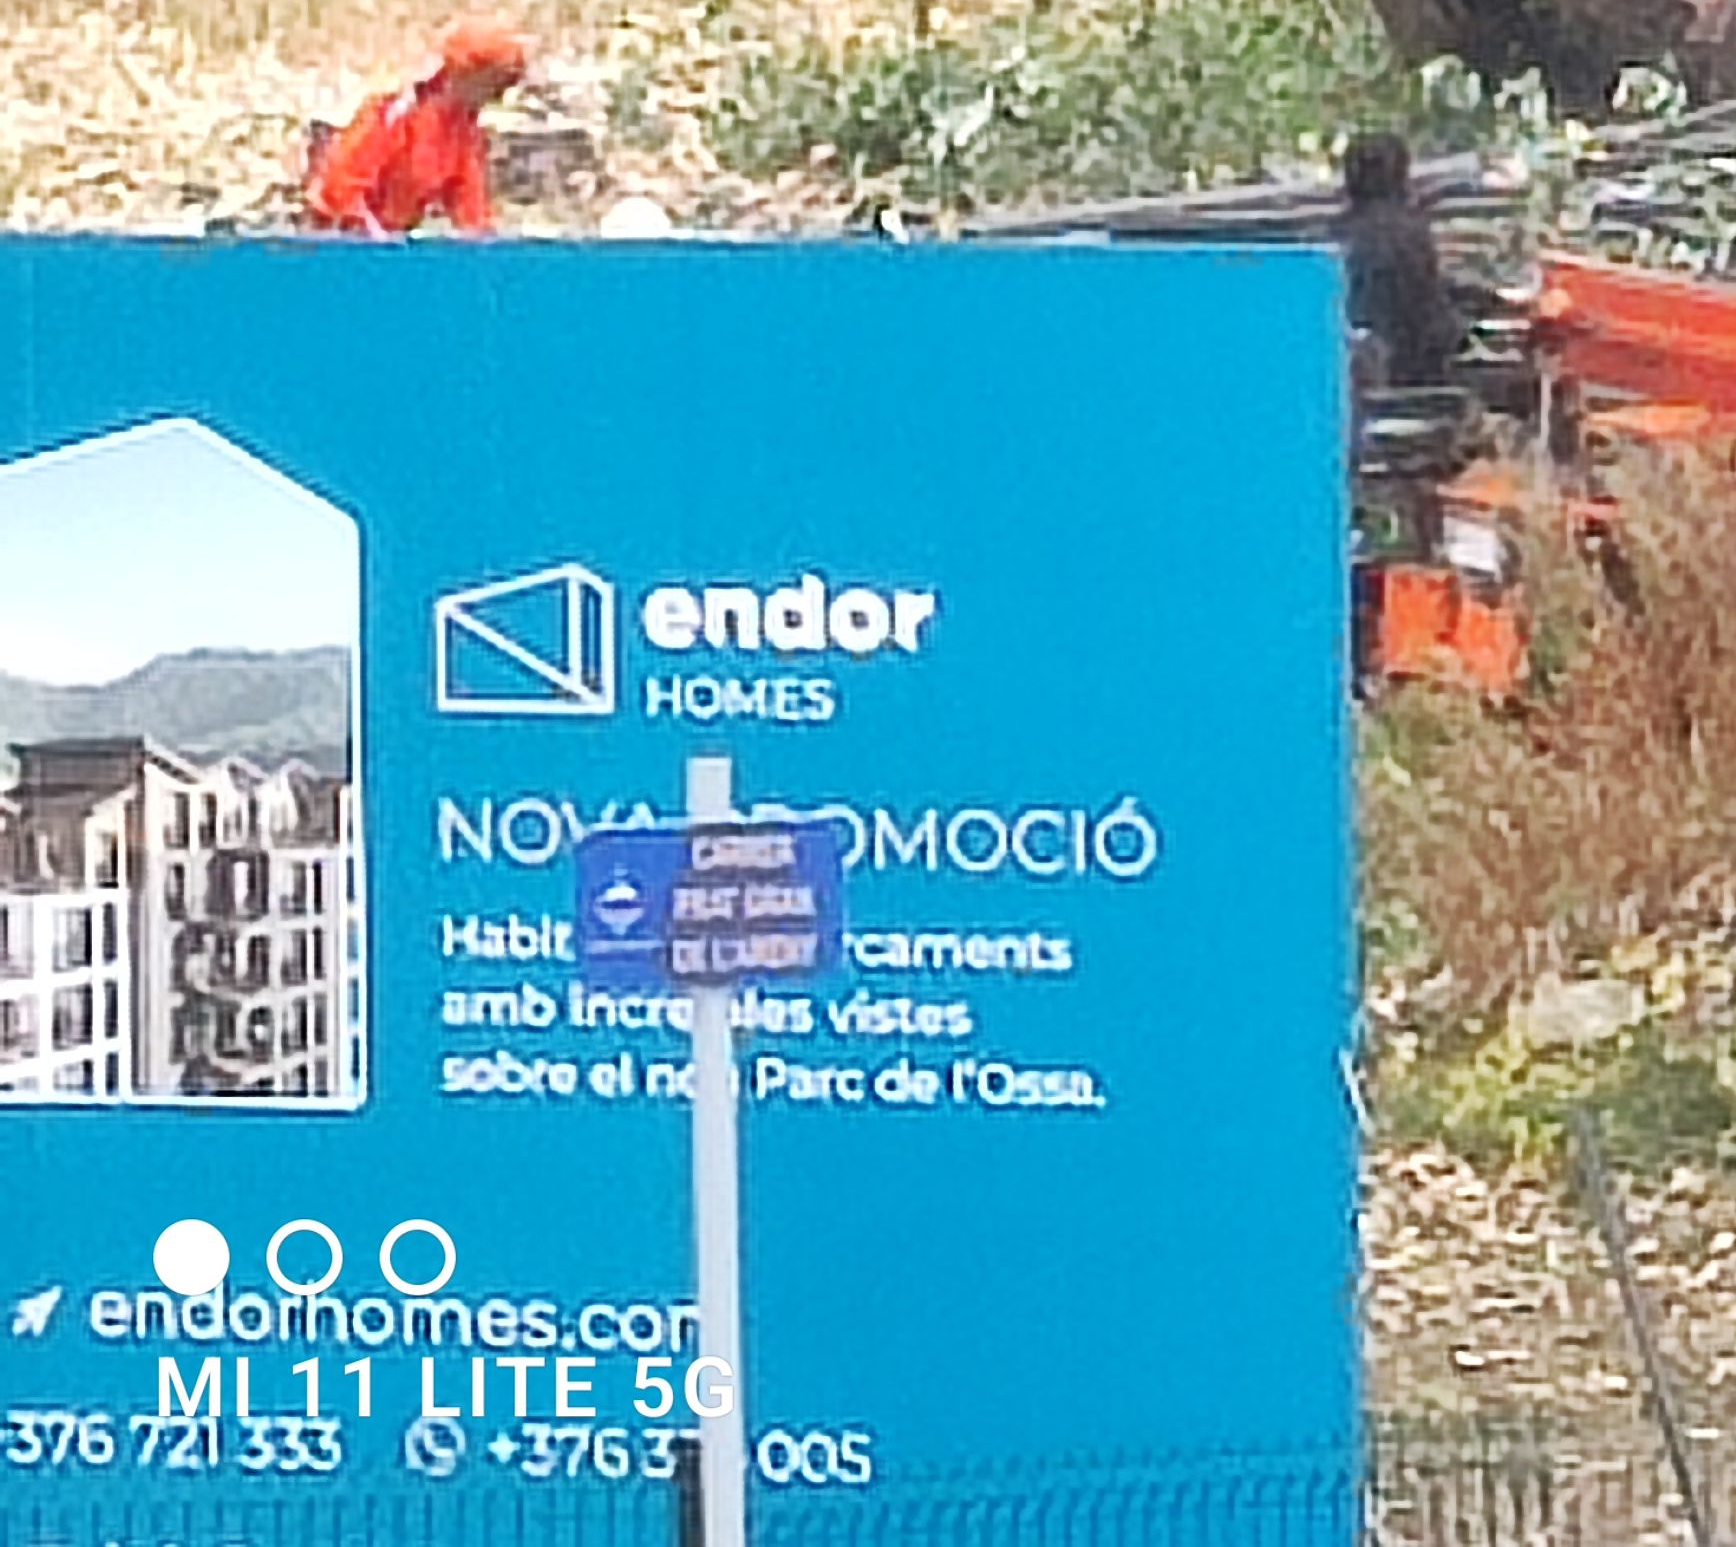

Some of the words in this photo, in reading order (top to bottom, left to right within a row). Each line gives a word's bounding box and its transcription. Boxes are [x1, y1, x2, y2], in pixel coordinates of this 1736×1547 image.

[643, 573, 935, 652] endor
[645, 676, 836, 722] HOMES
[437, 795, 660, 865] NOV
[735, 796, 1158, 877] OMOCIÓ
[443, 981, 556, 1028] amb
[569, 978, 815, 1035] increles
[828, 987, 974, 1037] vistes
[440, 1050, 577, 1096] sobre
[590, 1051, 635, 1099] el
[647, 1063, 739, 1100] no
[756, 1056, 865, 1102] Parc
[874, 1058, 941, 1104] de
[129, 1415, 219, 1470] 721
[238, 1416, 343, 1472] 333
[487, 1422, 629, 1479] +376
[756, 1428, 872, 1483] 005
